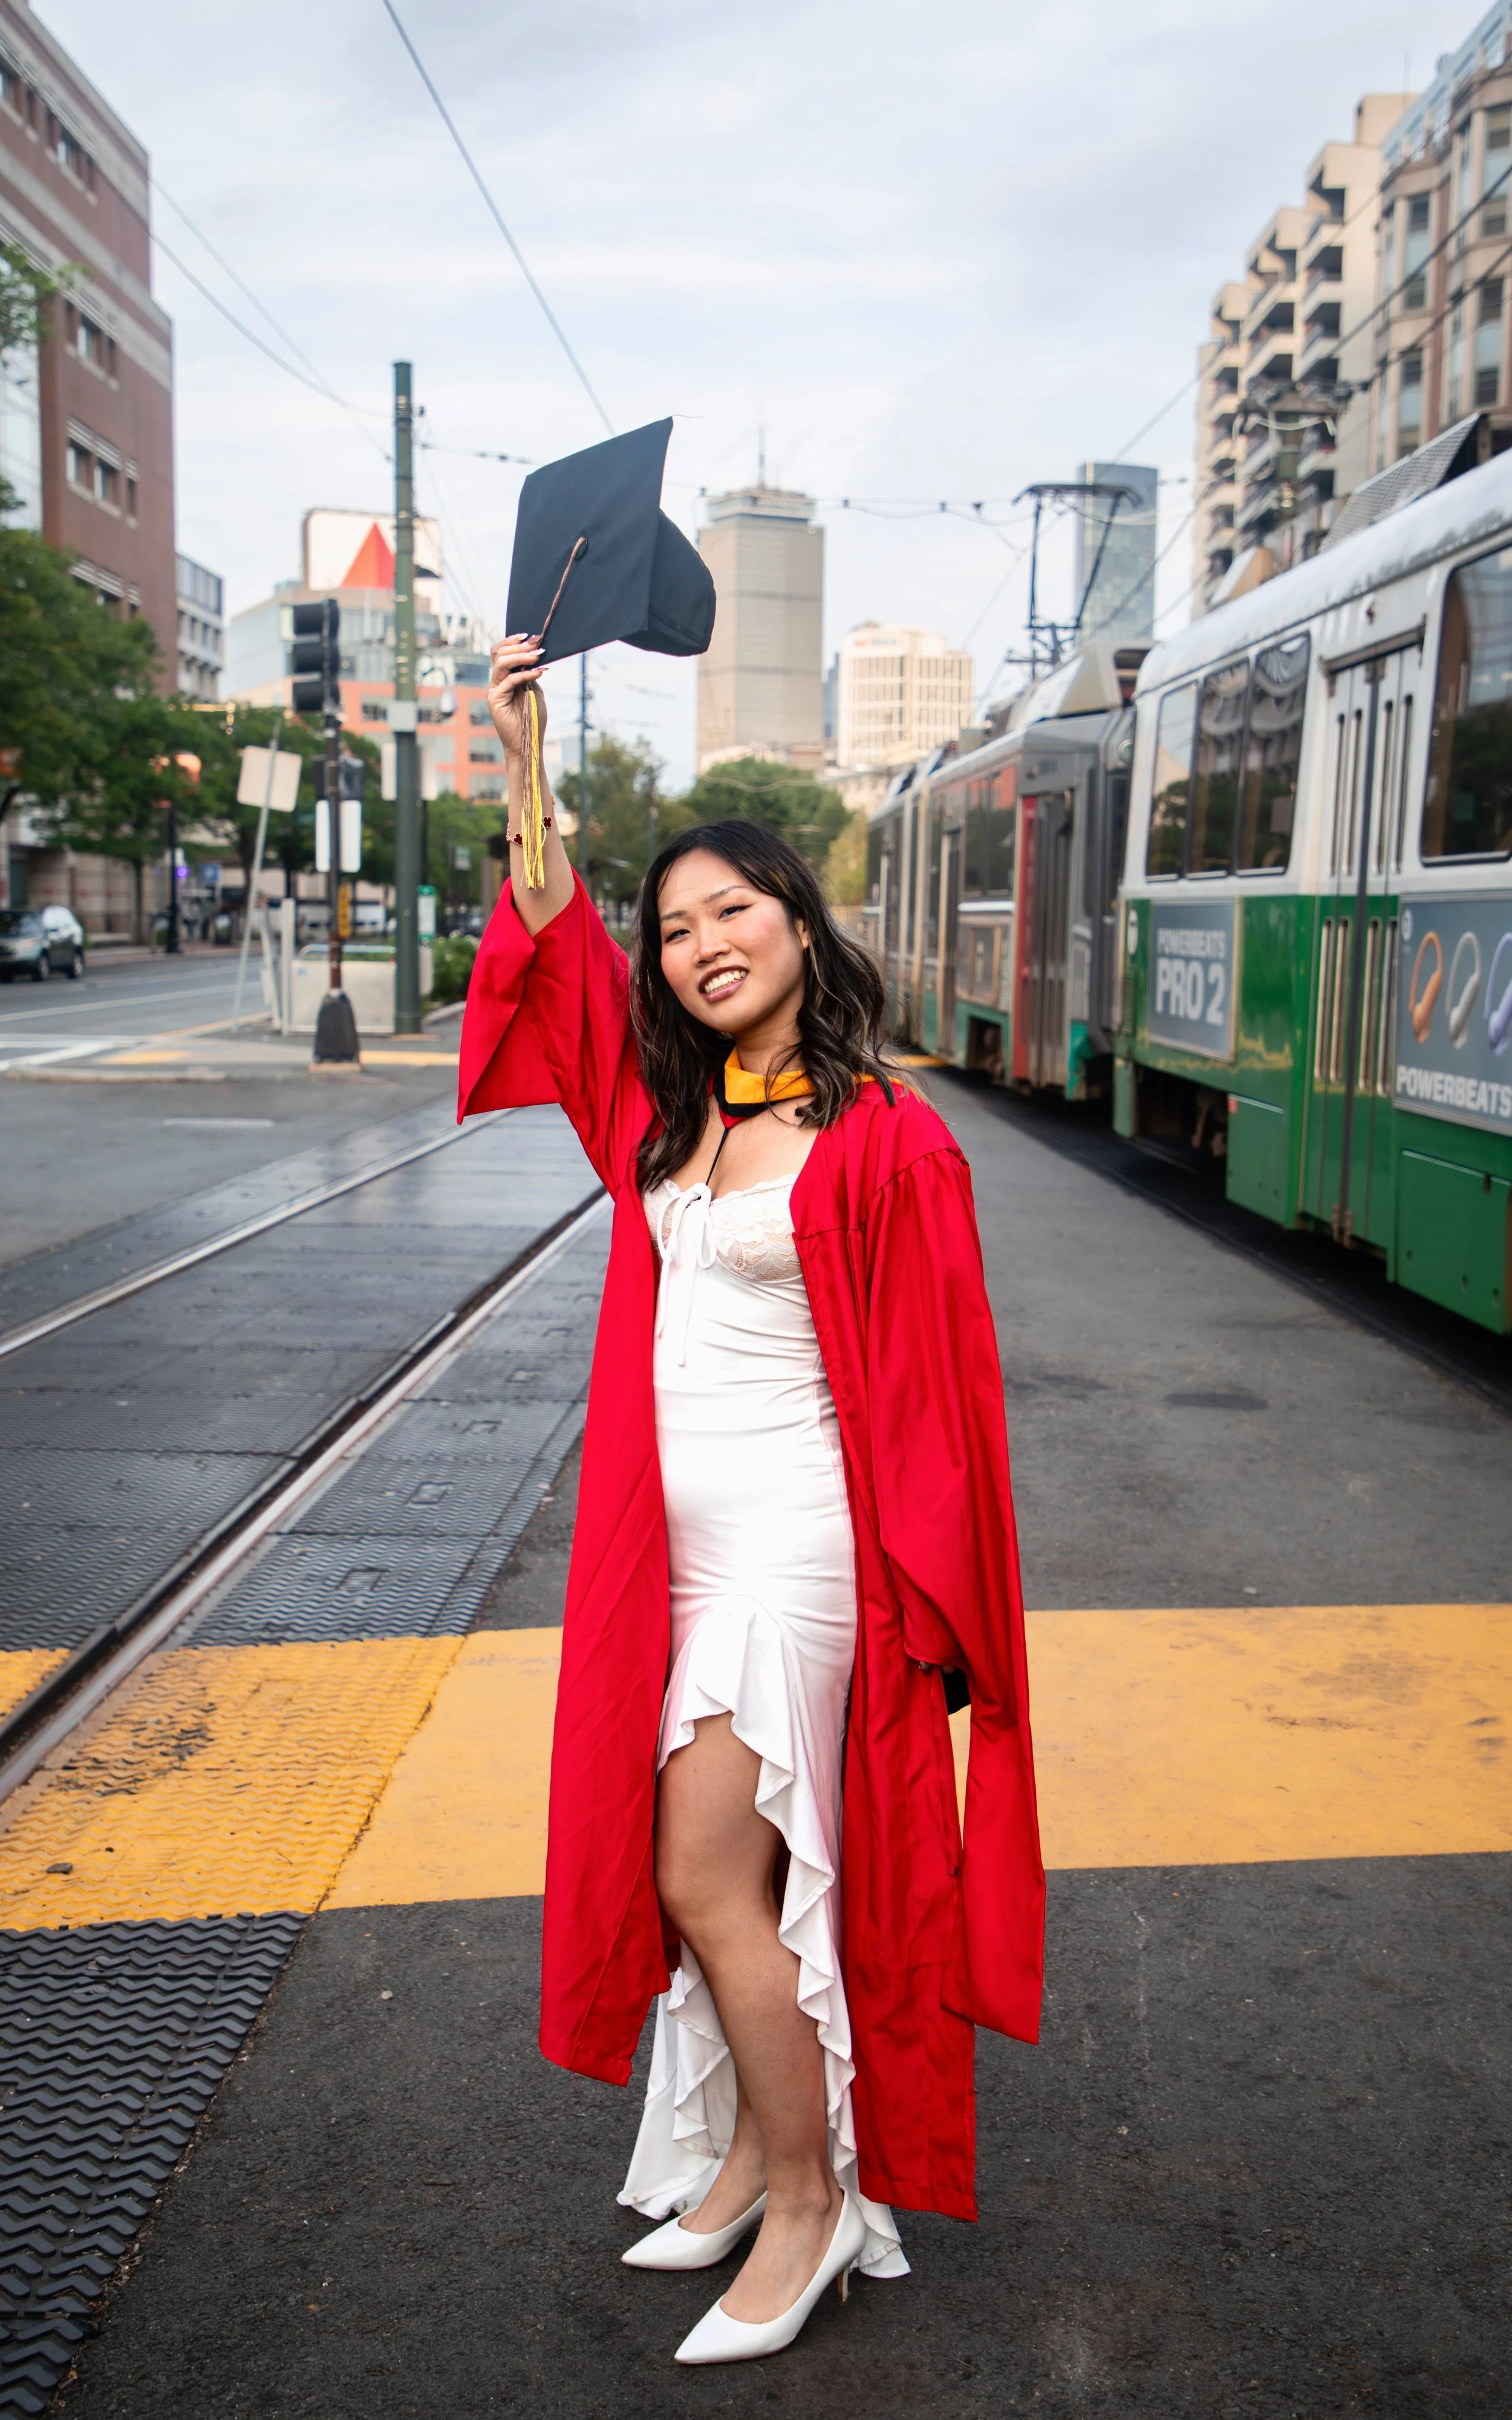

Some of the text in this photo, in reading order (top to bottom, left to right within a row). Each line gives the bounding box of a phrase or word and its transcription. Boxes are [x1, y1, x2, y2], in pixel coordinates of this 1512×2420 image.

[1157, 928, 1226, 961] POWERBEATS
[1155, 958, 1226, 1026] PRO 2
[1396, 1065, 1512, 1118] POWERBEATS
